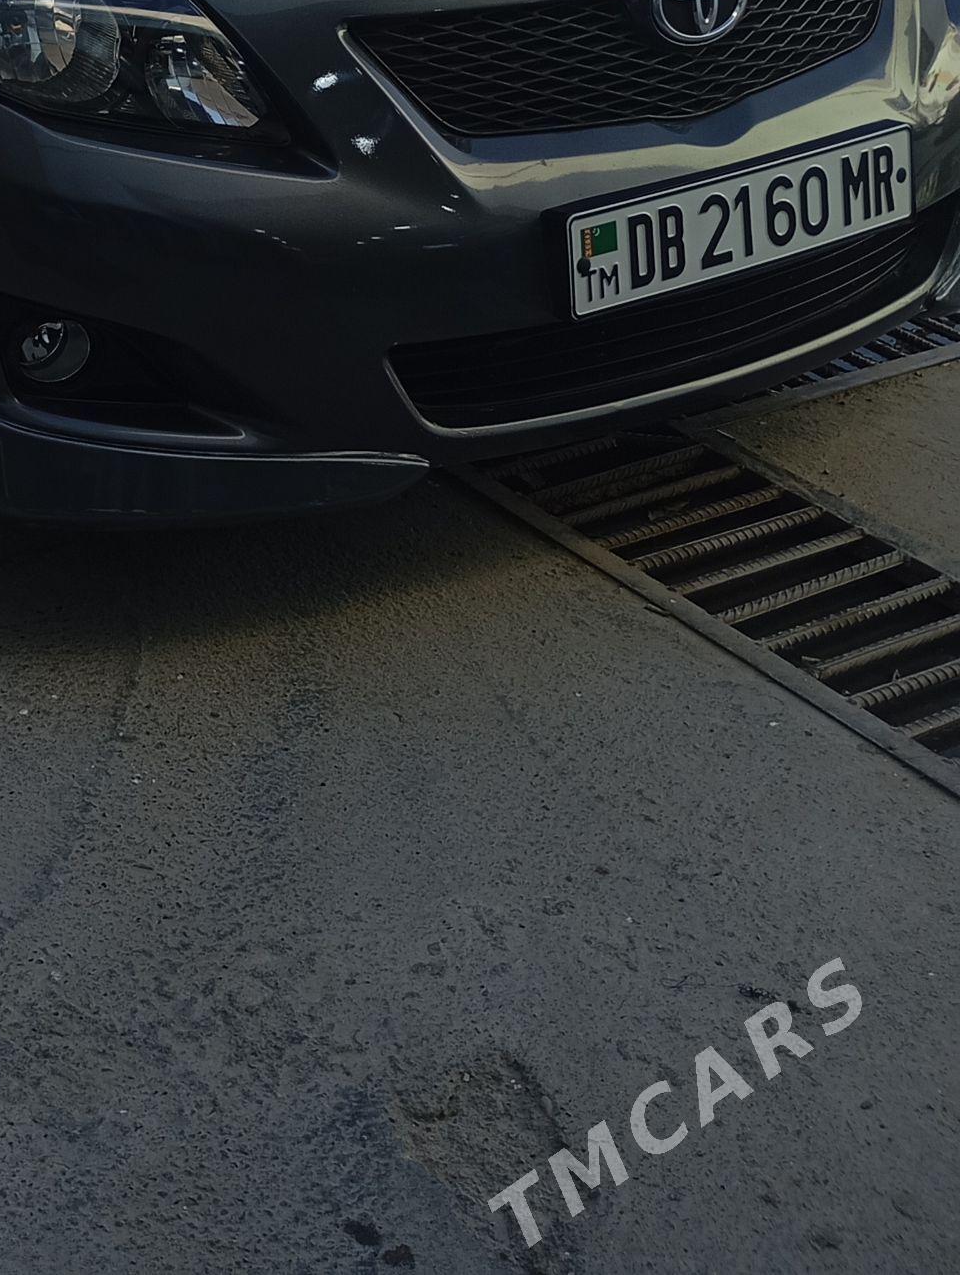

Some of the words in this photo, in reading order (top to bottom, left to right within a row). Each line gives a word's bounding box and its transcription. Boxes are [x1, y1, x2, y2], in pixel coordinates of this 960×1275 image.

[627, 203, 687, 290] DB
[697, 164, 830, 270] 2160
[841, 144, 896, 226] MR
[580, 262, 620, 302] TM
